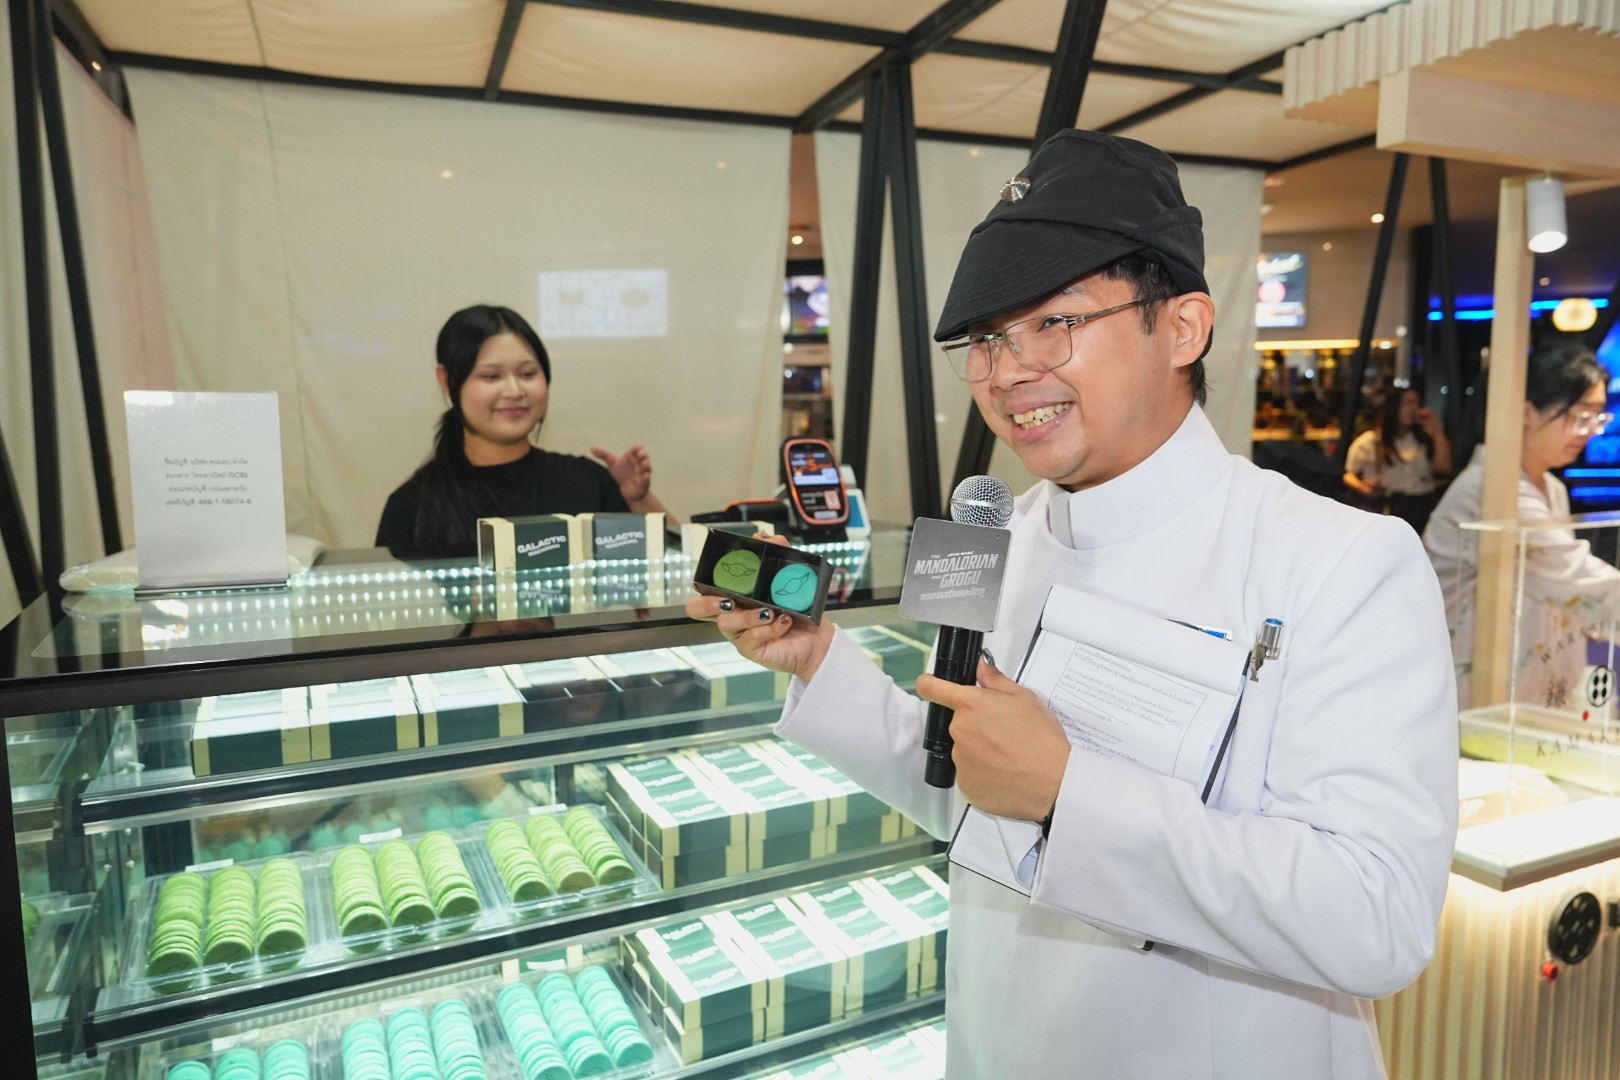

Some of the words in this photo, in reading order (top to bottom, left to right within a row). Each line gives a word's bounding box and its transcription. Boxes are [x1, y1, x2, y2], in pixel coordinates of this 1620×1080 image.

[517, 536, 566, 553] GALACTIC
[595, 532, 644, 545] GALACTIC
[914, 554, 998, 574] MANDALORIAN
[939, 570, 982, 588] GROGU
